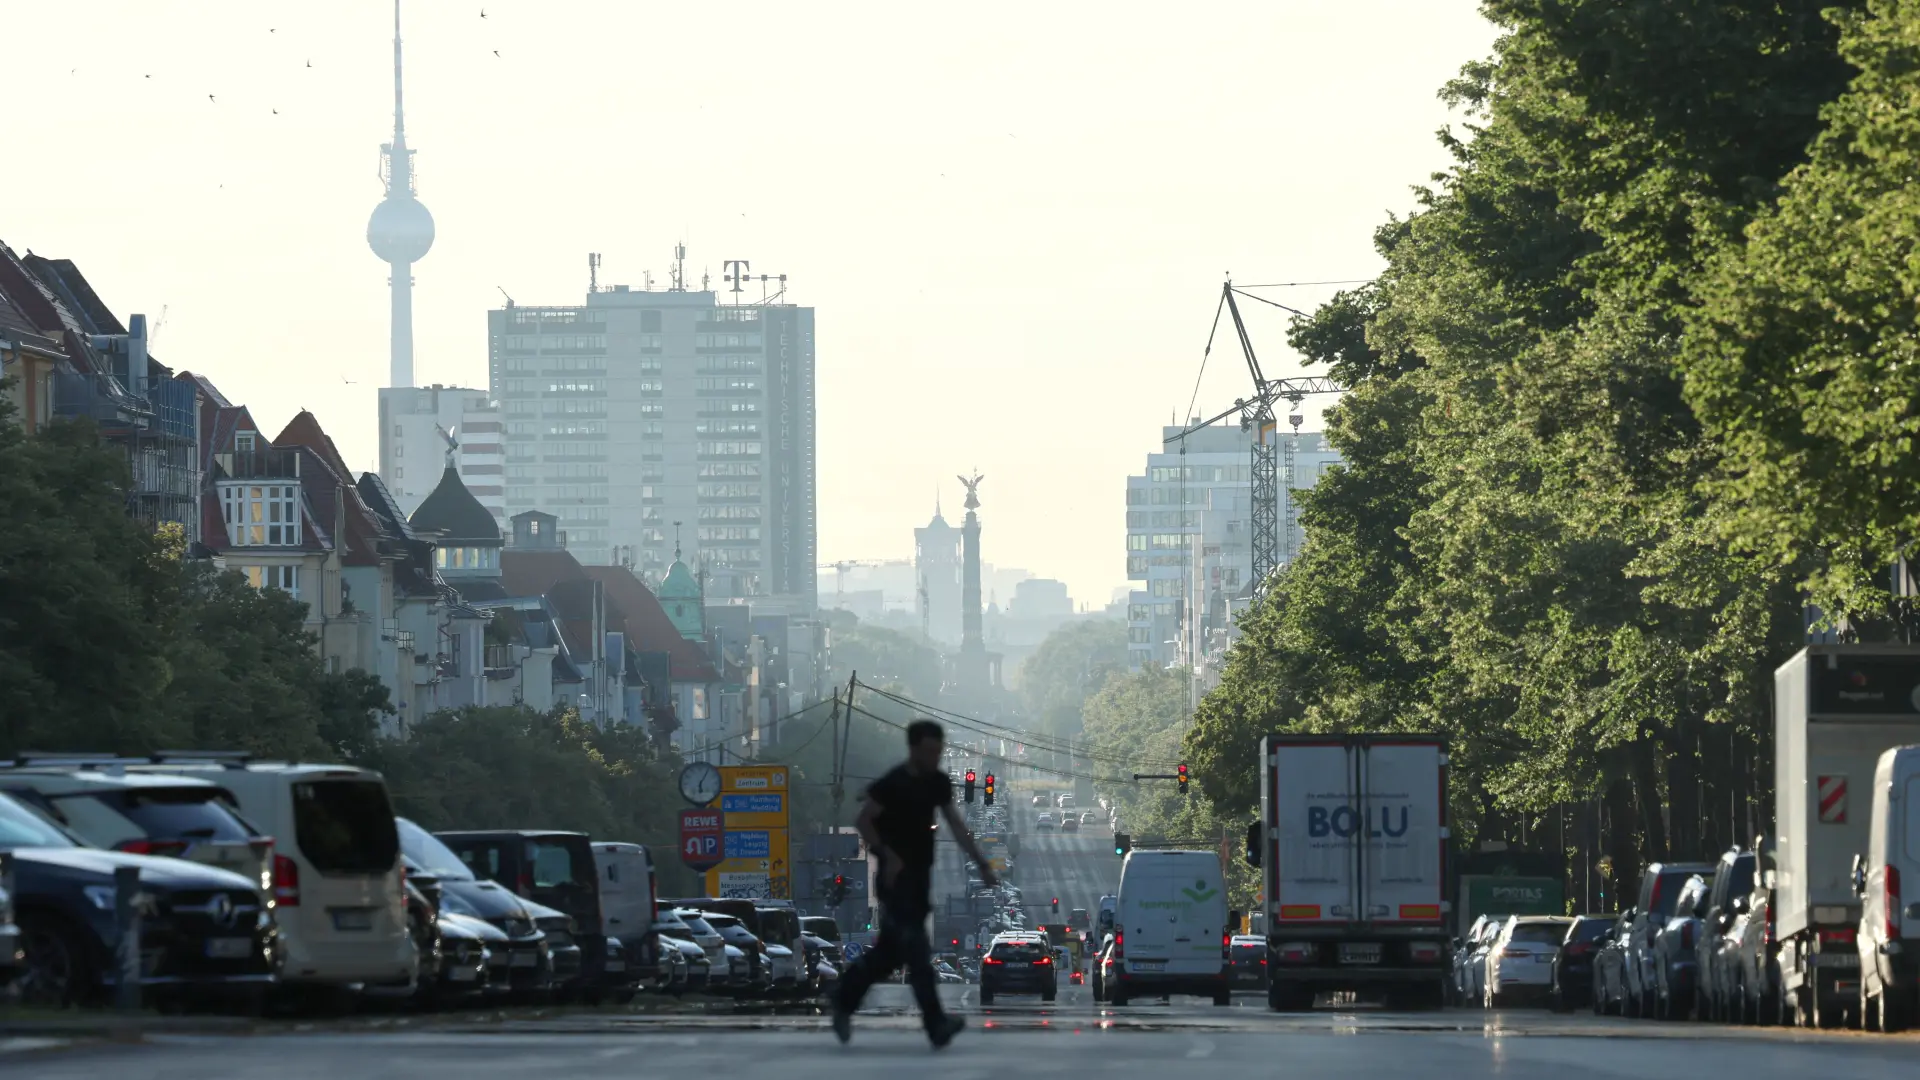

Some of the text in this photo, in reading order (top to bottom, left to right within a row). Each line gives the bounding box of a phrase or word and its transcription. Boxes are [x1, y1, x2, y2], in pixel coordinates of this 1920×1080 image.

[724, 260, 750, 292] T
[779, 320, 790, 451] TECHNISCHE
[737, 780, 766, 788] Zentrum
[684, 816, 718, 827] REWE
[1308, 805, 1408, 838] BOLU
[706, 838, 716, 854] P
[1492, 887, 1543, 899] PORTAS
